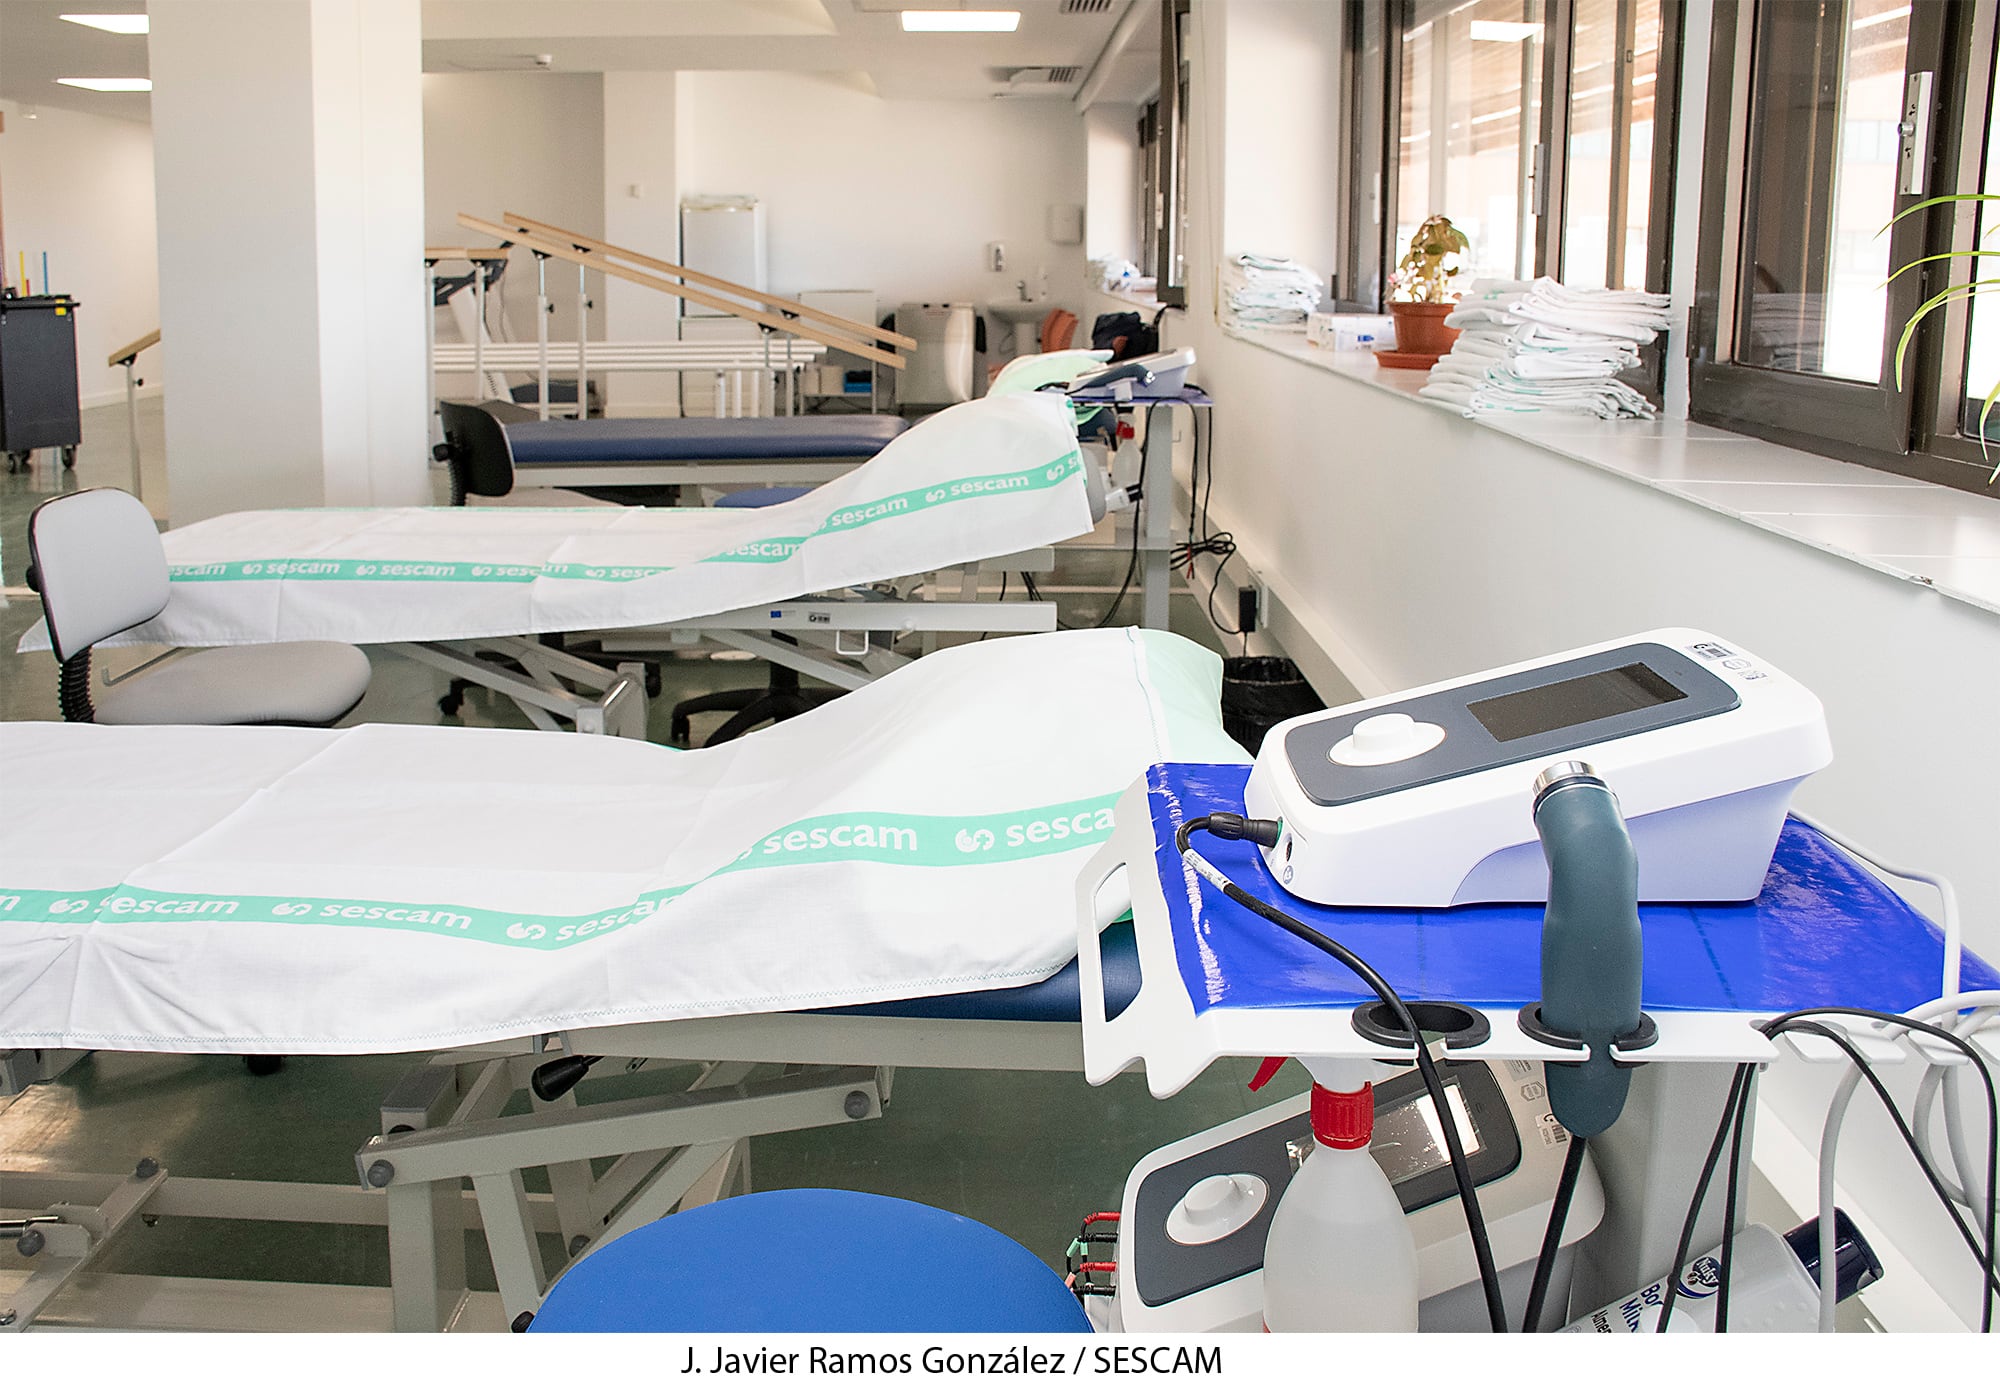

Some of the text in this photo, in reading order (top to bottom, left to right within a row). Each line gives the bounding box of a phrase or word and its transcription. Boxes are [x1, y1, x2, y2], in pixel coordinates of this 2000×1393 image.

[951, 474, 1030, 498] sescam
[832, 499, 908, 525] sescam
[266, 561, 341, 575] sescam
[381, 564, 456, 578] sescam
[763, 807, 1115, 856] sescam sesca
[319, 901, 473, 930] sescam
